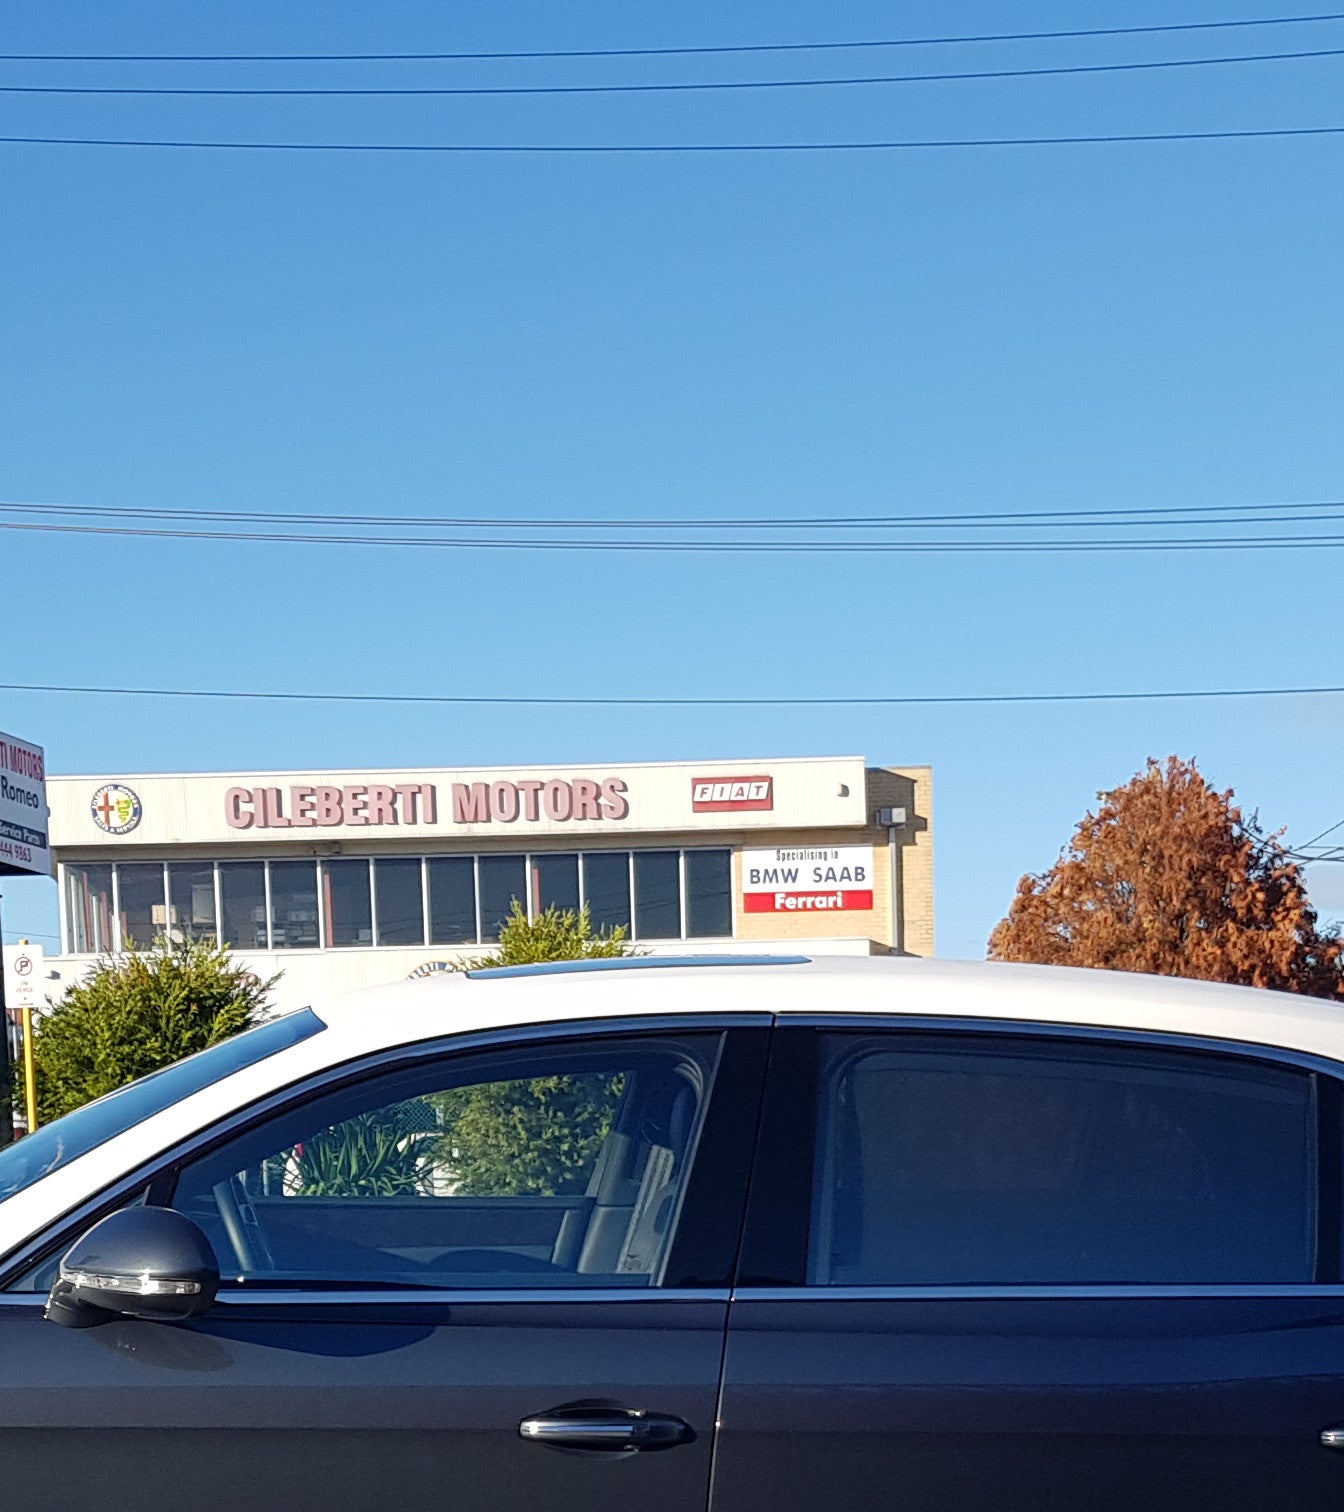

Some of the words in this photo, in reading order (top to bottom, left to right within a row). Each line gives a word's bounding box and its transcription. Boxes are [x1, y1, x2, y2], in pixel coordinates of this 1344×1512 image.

[9, 744, 44, 783] MOTORS
[0, 775, 39, 809] Romeo
[699, 783, 767, 801] FIAT
[224, 782, 438, 829] CILEBERTI
[451, 776, 630, 824] MOTORS
[776, 849, 828, 862] Specialising
[831, 849, 839, 860] in
[750, 868, 799, 884] BMW
[813, 866, 866, 883] SAAB
[774, 891, 843, 909] Ferrari
